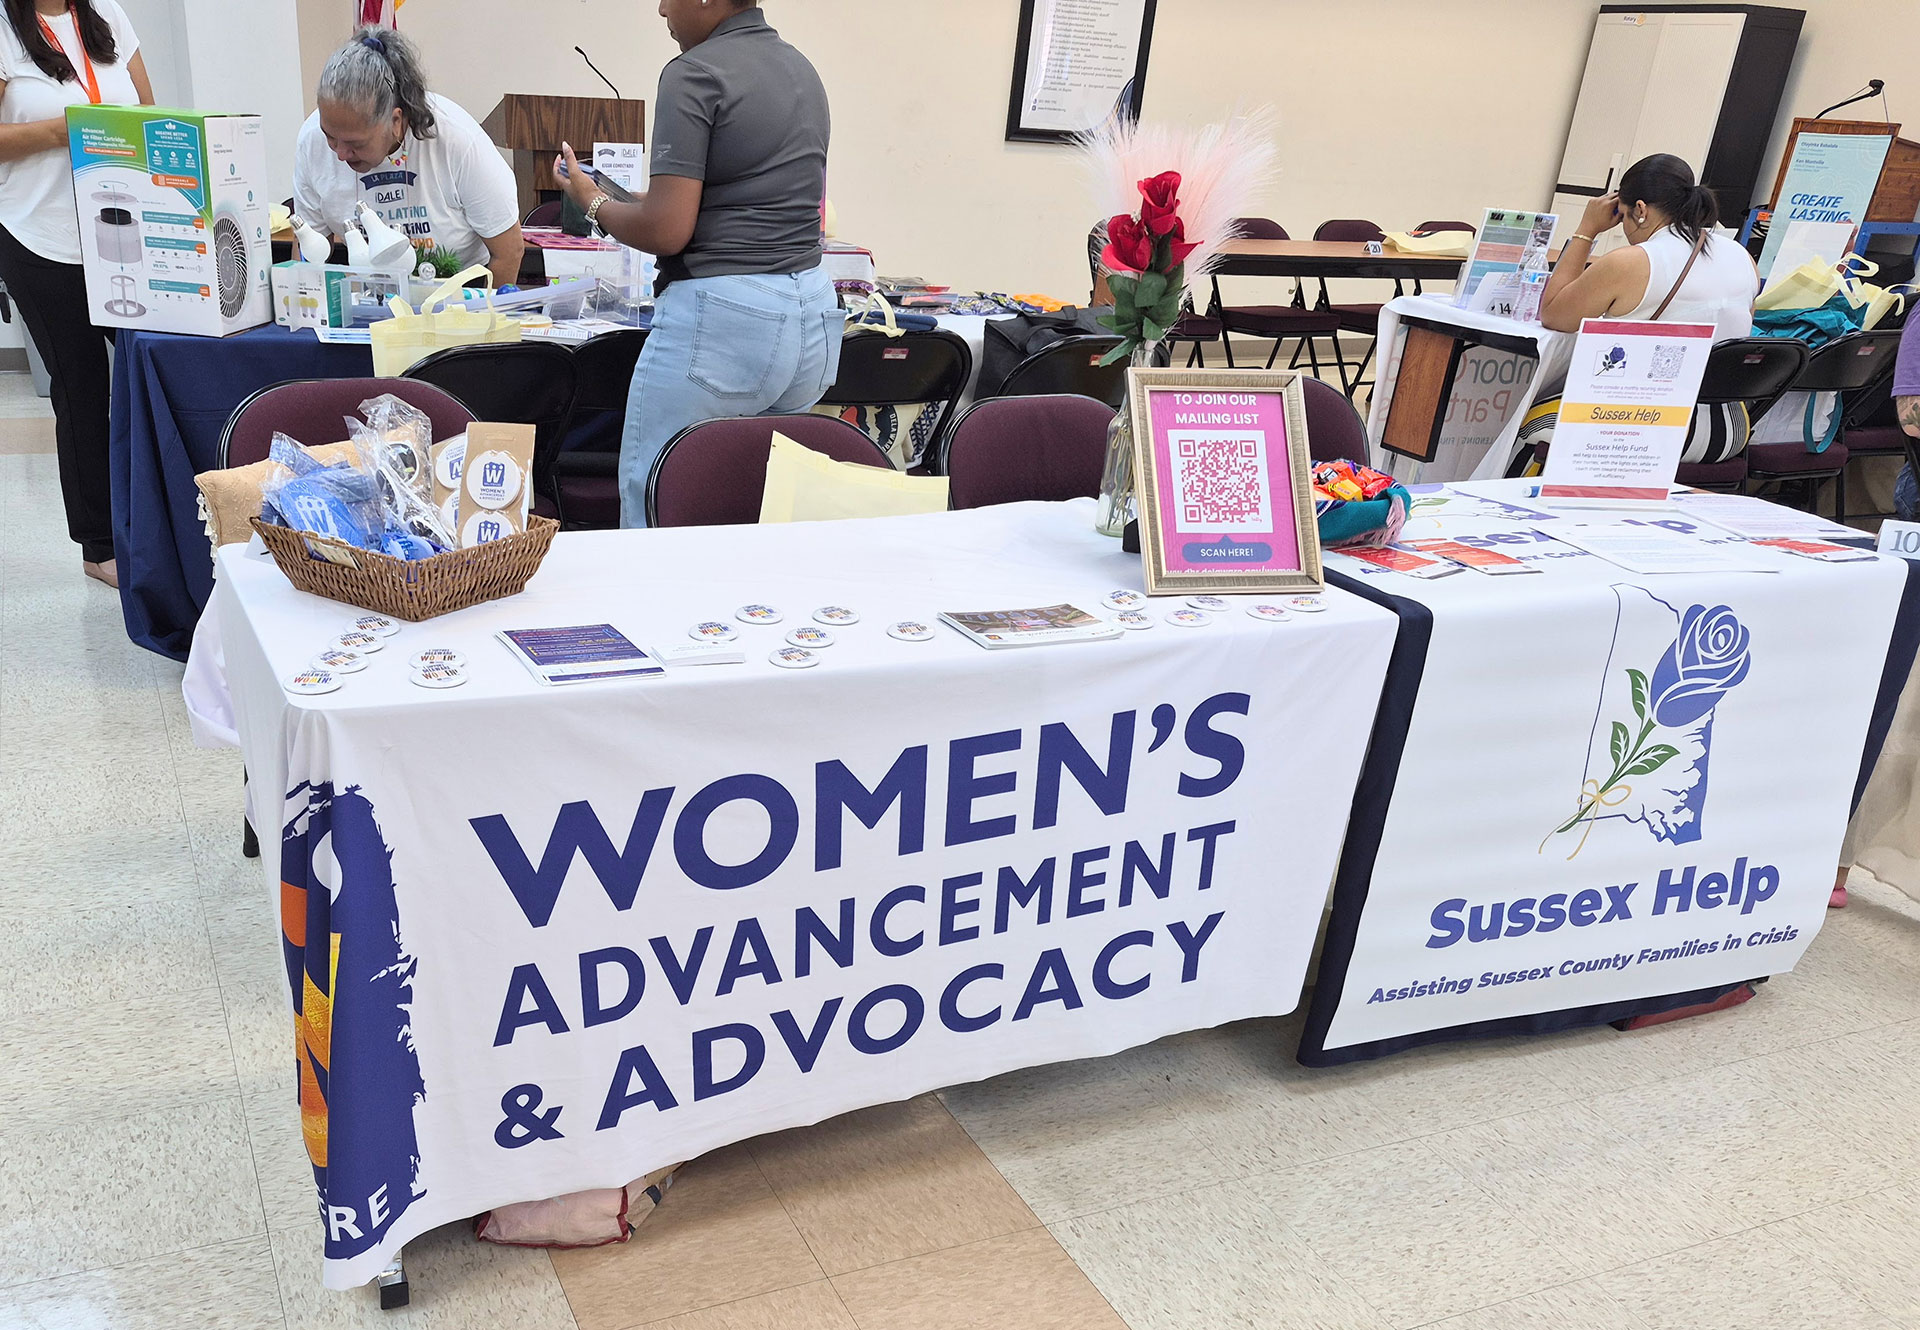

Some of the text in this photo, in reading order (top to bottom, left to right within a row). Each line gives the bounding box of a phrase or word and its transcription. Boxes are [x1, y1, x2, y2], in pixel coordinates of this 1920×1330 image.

[1790, 193, 1844, 208] CREATE
[1789, 208, 1850, 222] LASTING
[1500, 303, 1512, 314] 14
[1174, 394, 1257, 406] TO JOIN OUR
[1176, 413, 1259, 425] MAILING LIST
[1590, 407, 1661, 424] Sussex Help
[1586, 443, 1648, 453] Sussex Help Fund
[1892, 530, 1920, 554] 10
[1200, 548, 1254, 556] SCAN HERE!
[468, 692, 1251, 929] WOMEN'S
[1425, 856, 1780, 949] Sussex Help
[492, 820, 1236, 1047] ADVANCEMENT
[1367, 925, 1799, 1005] Assisting Sussex County Families in Crisis
[494, 911, 1225, 1149] & ADVOCACY
[322, 1182, 391, 1242] RE
